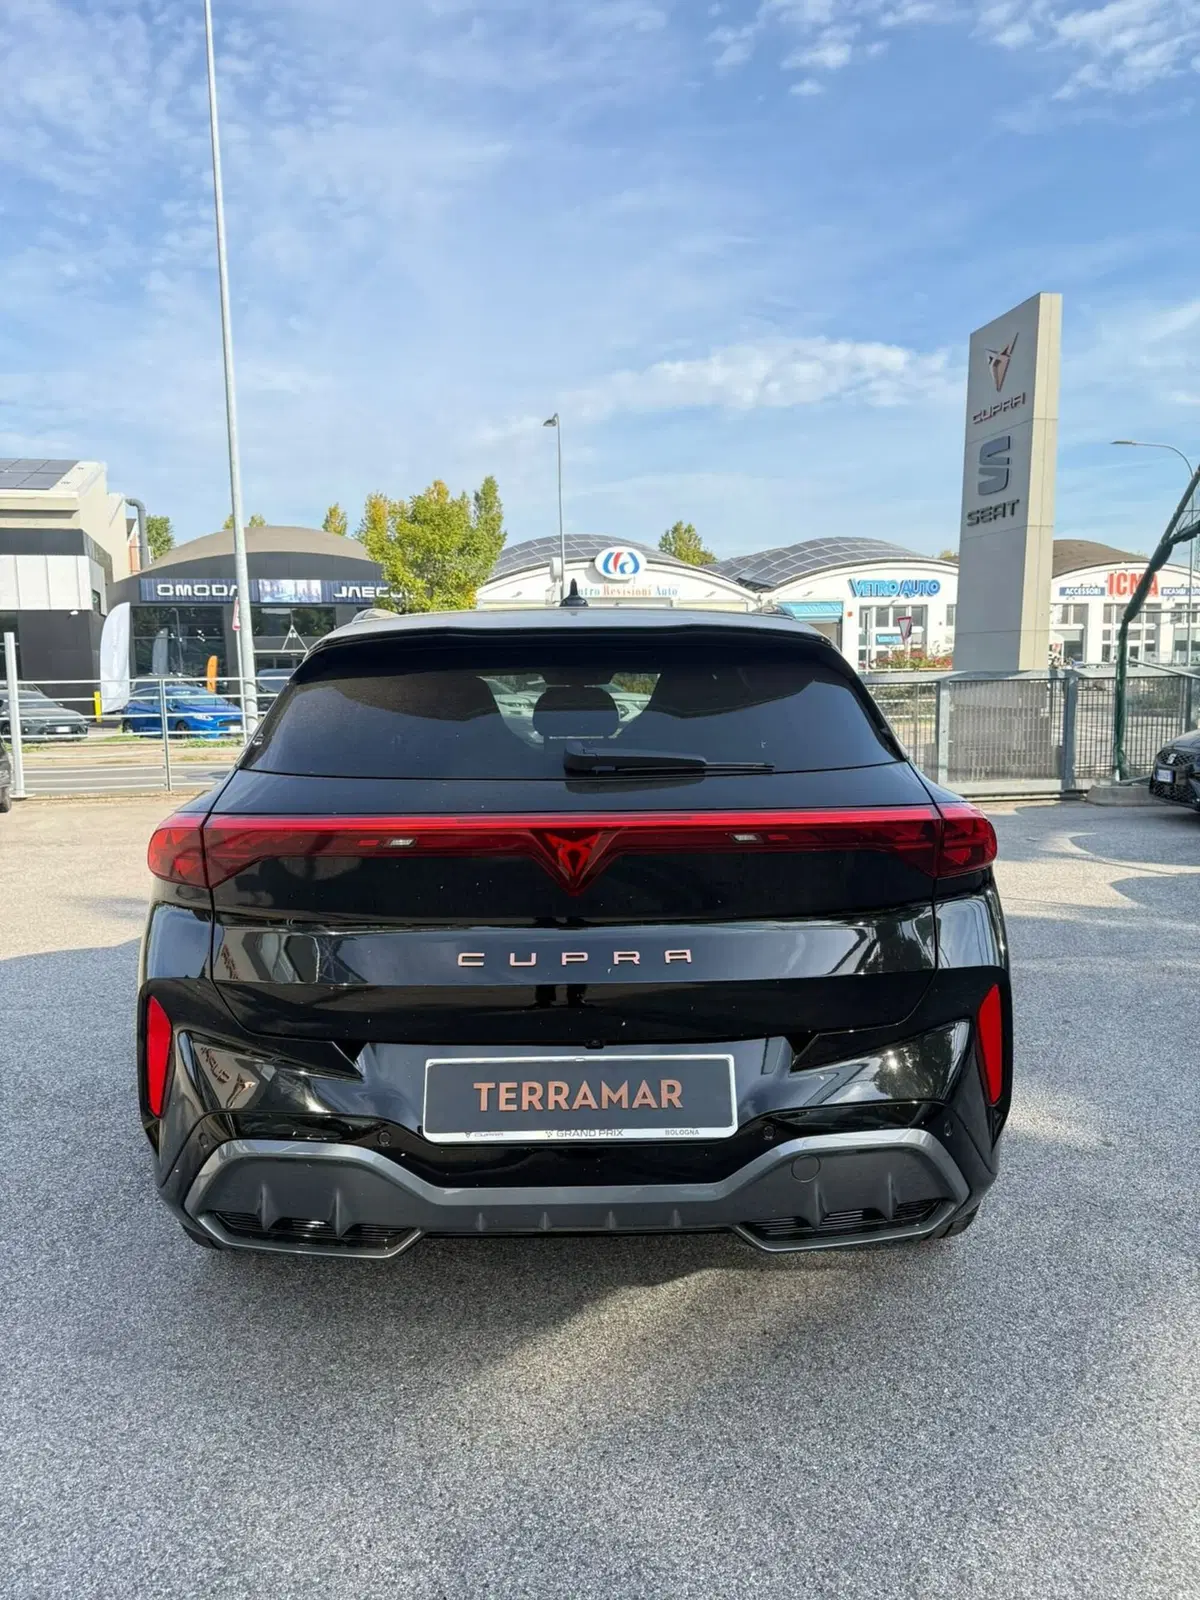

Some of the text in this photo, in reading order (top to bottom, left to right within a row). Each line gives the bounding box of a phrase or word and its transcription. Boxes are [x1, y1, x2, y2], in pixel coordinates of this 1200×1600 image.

[972, 392, 1026, 425] CUPRA
[967, 499, 1020, 527] SEAT
[333, 585, 406, 598] JAEC
[656, 585, 678, 596] Auto
[457, 949, 692, 967] CUPRA
[473, 1079, 683, 1112] TERRAMAR
[556, 1128, 624, 1138] GRAND PRIX
[664, 1128, 700, 1136] BOLOGNA
